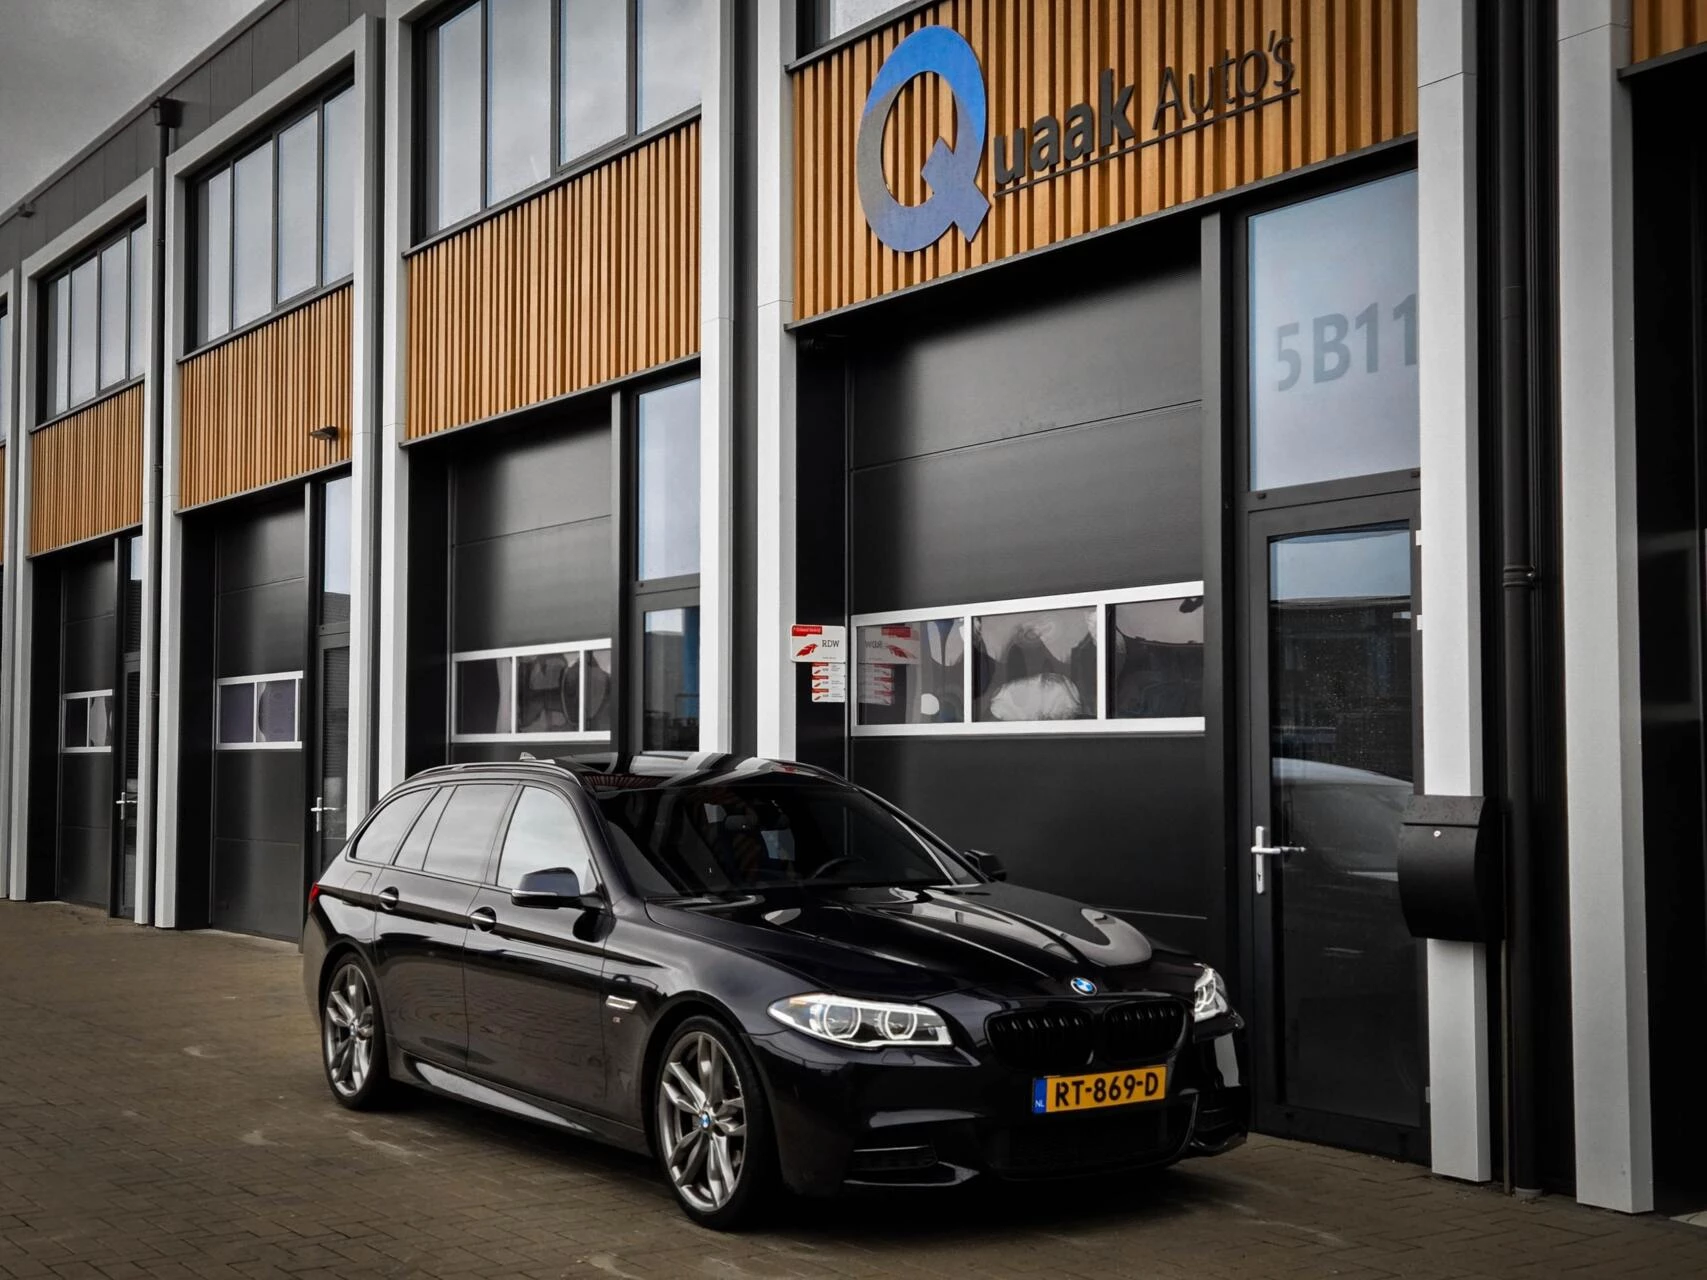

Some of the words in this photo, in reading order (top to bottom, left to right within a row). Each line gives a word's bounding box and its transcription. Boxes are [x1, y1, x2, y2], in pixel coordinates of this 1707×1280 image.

[857, 25, 1135, 252] Quaak
[1152, 30, 1293, 130] Auto's
[1276, 293, 1417, 392] 5B11
[821, 639, 840, 648] RDW
[1035, 1100, 1044, 1108] NL
[1055, 1072, 1158, 1107] RT-869-D
